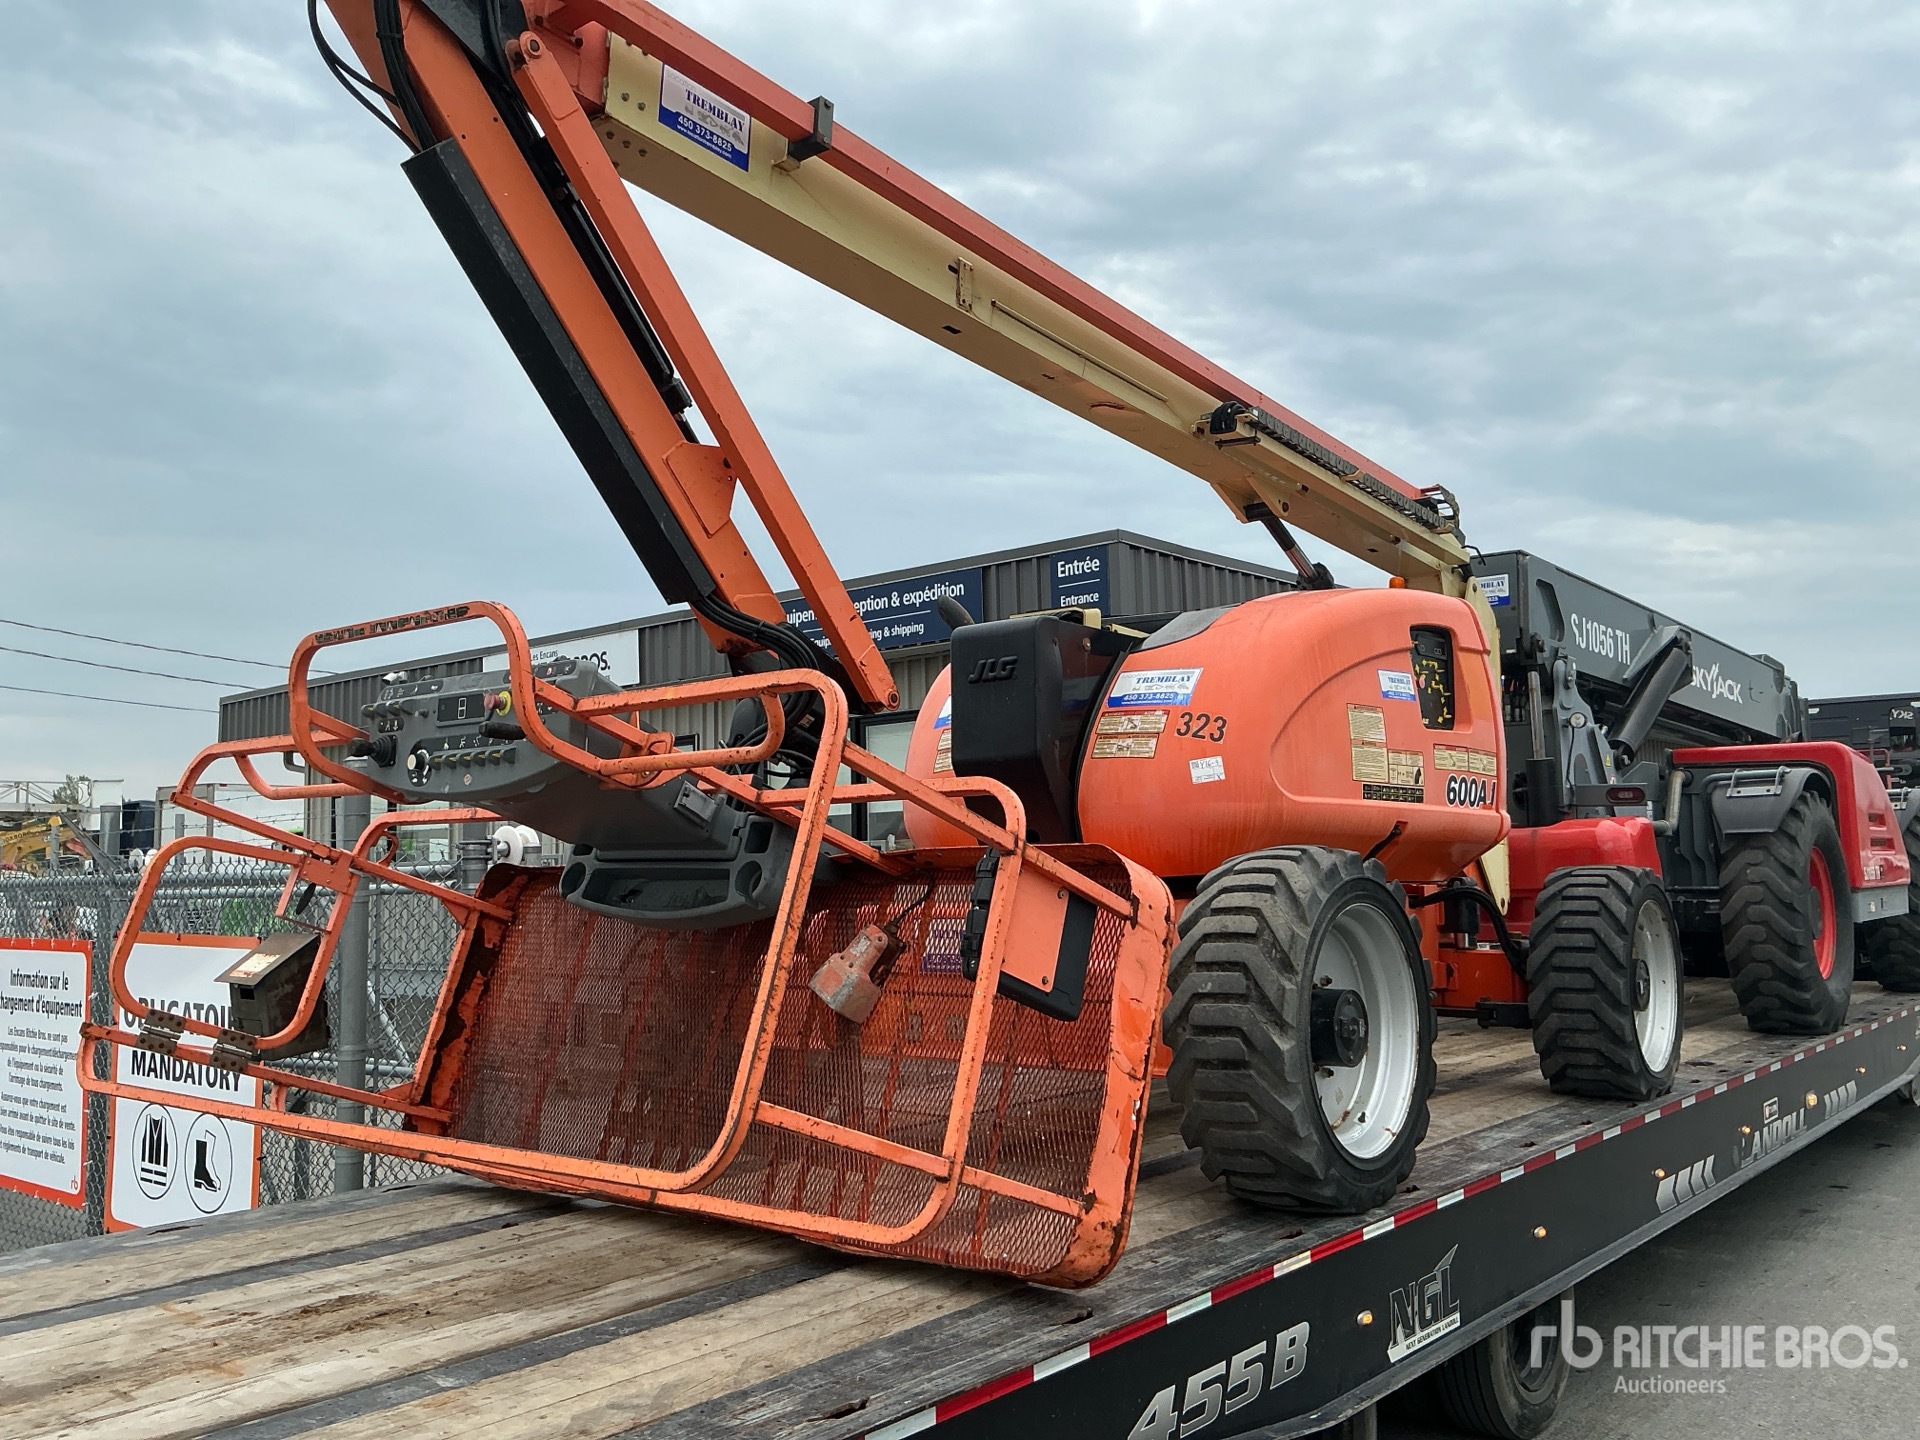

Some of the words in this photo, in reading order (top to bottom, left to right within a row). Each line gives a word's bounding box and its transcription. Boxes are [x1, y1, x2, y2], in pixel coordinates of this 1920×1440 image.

[685, 89, 745, 132] TREMBLAY
[678, 115, 693, 130] 450
[695, 125, 733, 152] 373-8825
[1057, 556, 1100, 578] Entrée
[853, 595, 888, 616] eption
[891, 591, 900, 607] &
[902, 581, 965, 608] expédition
[1060, 592, 1099, 607] Entrance
[884, 626, 890, 637] &
[891, 622, 924, 638] shipping
[1570, 612, 1614, 659] SJ1056
[1615, 629, 1631, 665] TH
[540, 650, 559, 660] Encans
[967, 655, 1018, 684] JLG
[1135, 674, 1194, 684] TREMBLAY
[1123, 693, 1138, 701] 450
[1176, 711, 1228, 743] 323
[1446, 774, 1497, 808] 600AJ
[10, 968, 48, 989] Information
[49, 974, 61, 990] sur
[62, 971, 69, 991] le
[0, 991, 34, 1015] hargement
[36, 994, 82, 1019] d'équipement
[131, 1050, 241, 1092] MANDATORY
[1389, 1265, 1460, 1349] NGL
[1405, 1339, 1416, 1350] NEXT
